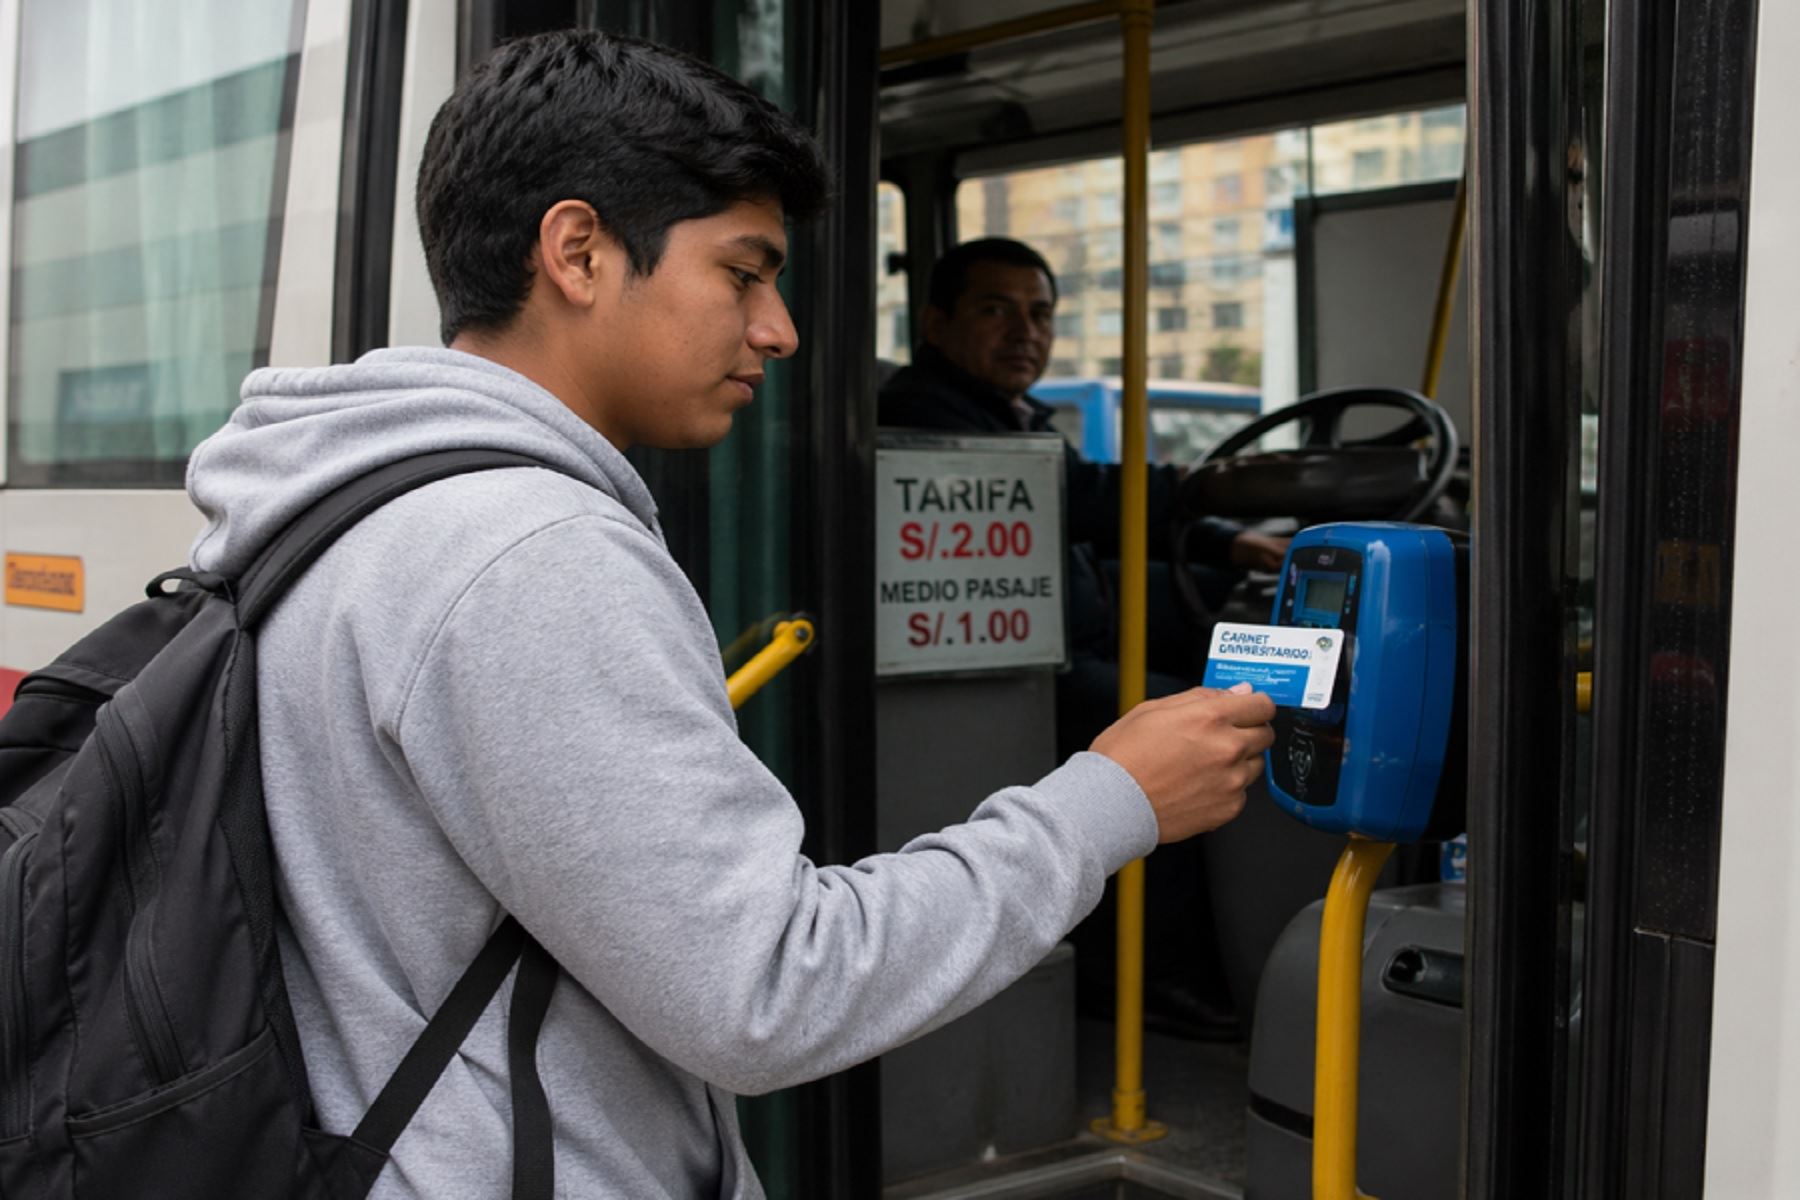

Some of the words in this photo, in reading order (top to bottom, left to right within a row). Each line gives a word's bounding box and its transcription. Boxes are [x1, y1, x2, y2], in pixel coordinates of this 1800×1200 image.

[894, 479, 1034, 512] TARIFA
[899, 521, 1033, 561] S/.2.00
[881, 580, 959, 604] MEDIO
[966, 577, 1053, 600] PASAJE
[908, 609, 1030, 648] S/.1.00
[1221, 631, 1270, 645] CARNET
